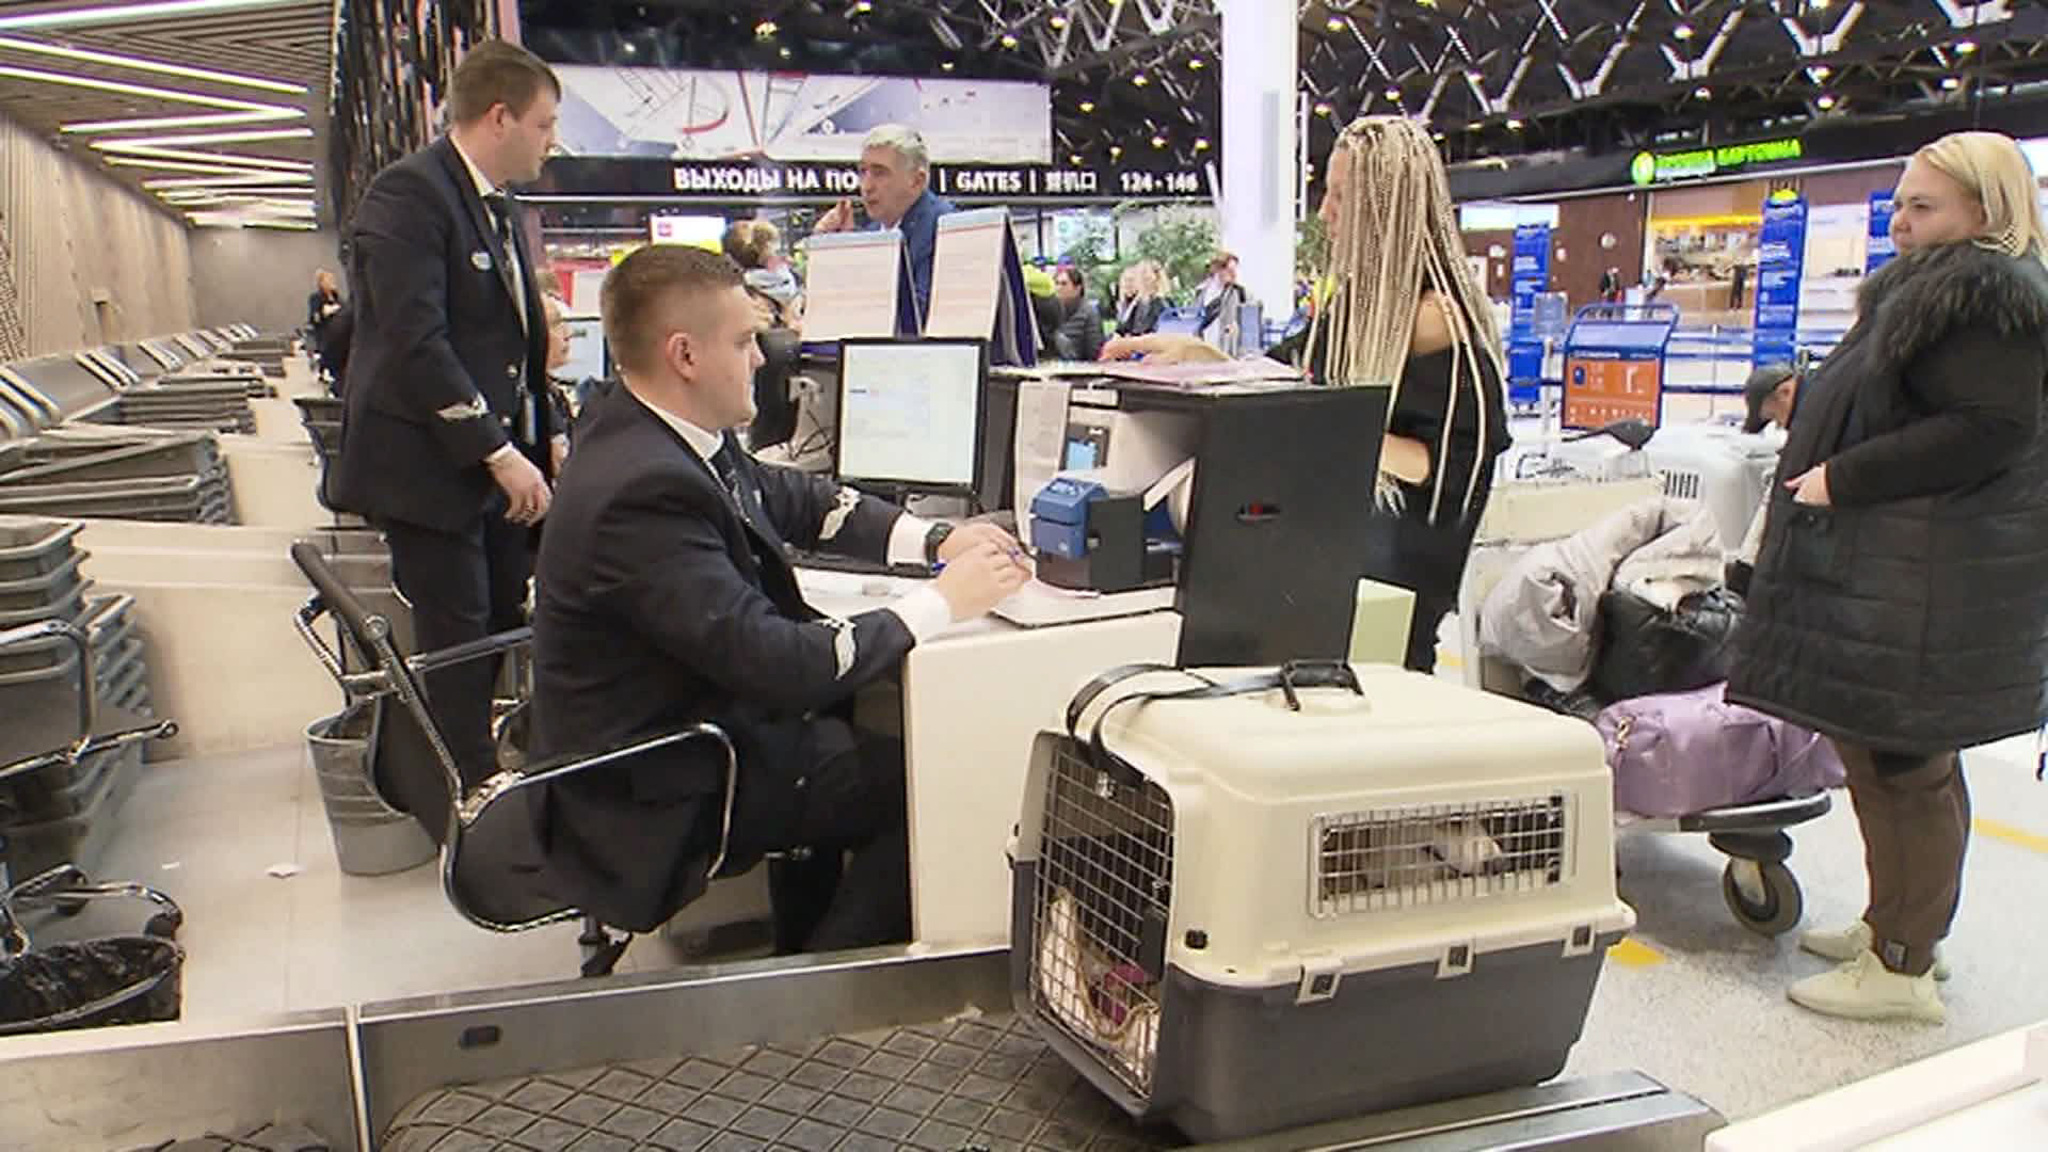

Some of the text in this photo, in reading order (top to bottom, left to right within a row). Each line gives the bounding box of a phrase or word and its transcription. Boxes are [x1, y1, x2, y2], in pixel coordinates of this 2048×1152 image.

[674, 167, 781, 192] ВЫХОДЫ
[786, 168, 820, 189] НА
[956, 171, 1022, 192] GATES
